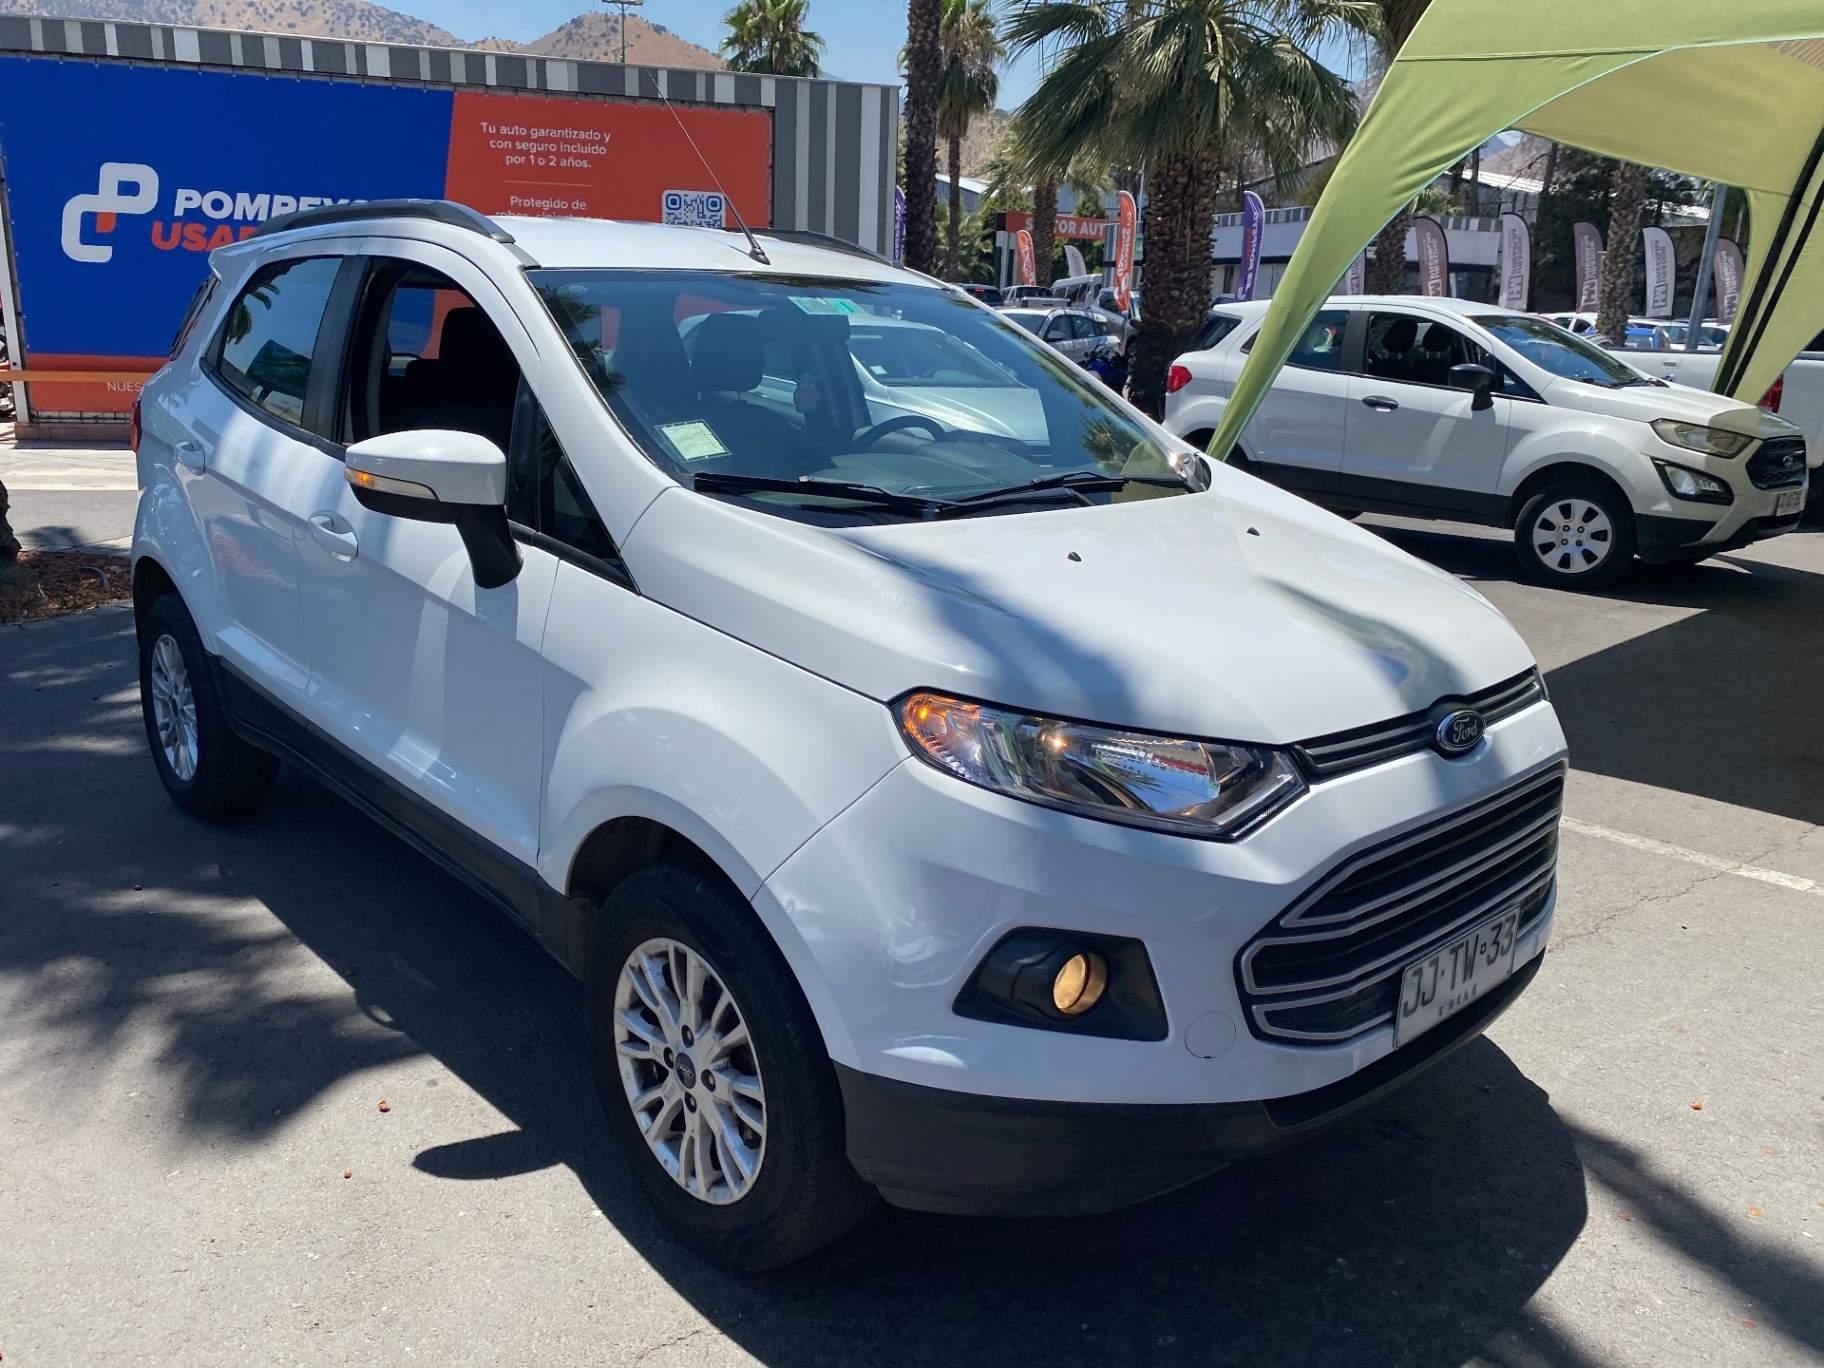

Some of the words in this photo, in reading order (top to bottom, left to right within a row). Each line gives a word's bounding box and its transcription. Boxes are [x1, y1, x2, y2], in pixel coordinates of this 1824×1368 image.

[480, 122, 496, 134] Tu
[500, 125, 527, 136] auto
[530, 127, 601, 141] garantizado
[603, 131, 611, 144] y
[489, 139, 512, 150] con
[515, 140, 557, 153] seguro
[560, 141, 607, 155] incluido
[505, 154, 526, 166] por
[529, 154, 535, 166] 1
[537, 156, 546, 166] o
[548, 155, 557, 167] 2
[560, 156, 592, 169] años.
[510, 195, 569, 211] Protegido
[571, 199, 588, 210] de
[1453, 716, 1478, 743] Ford
